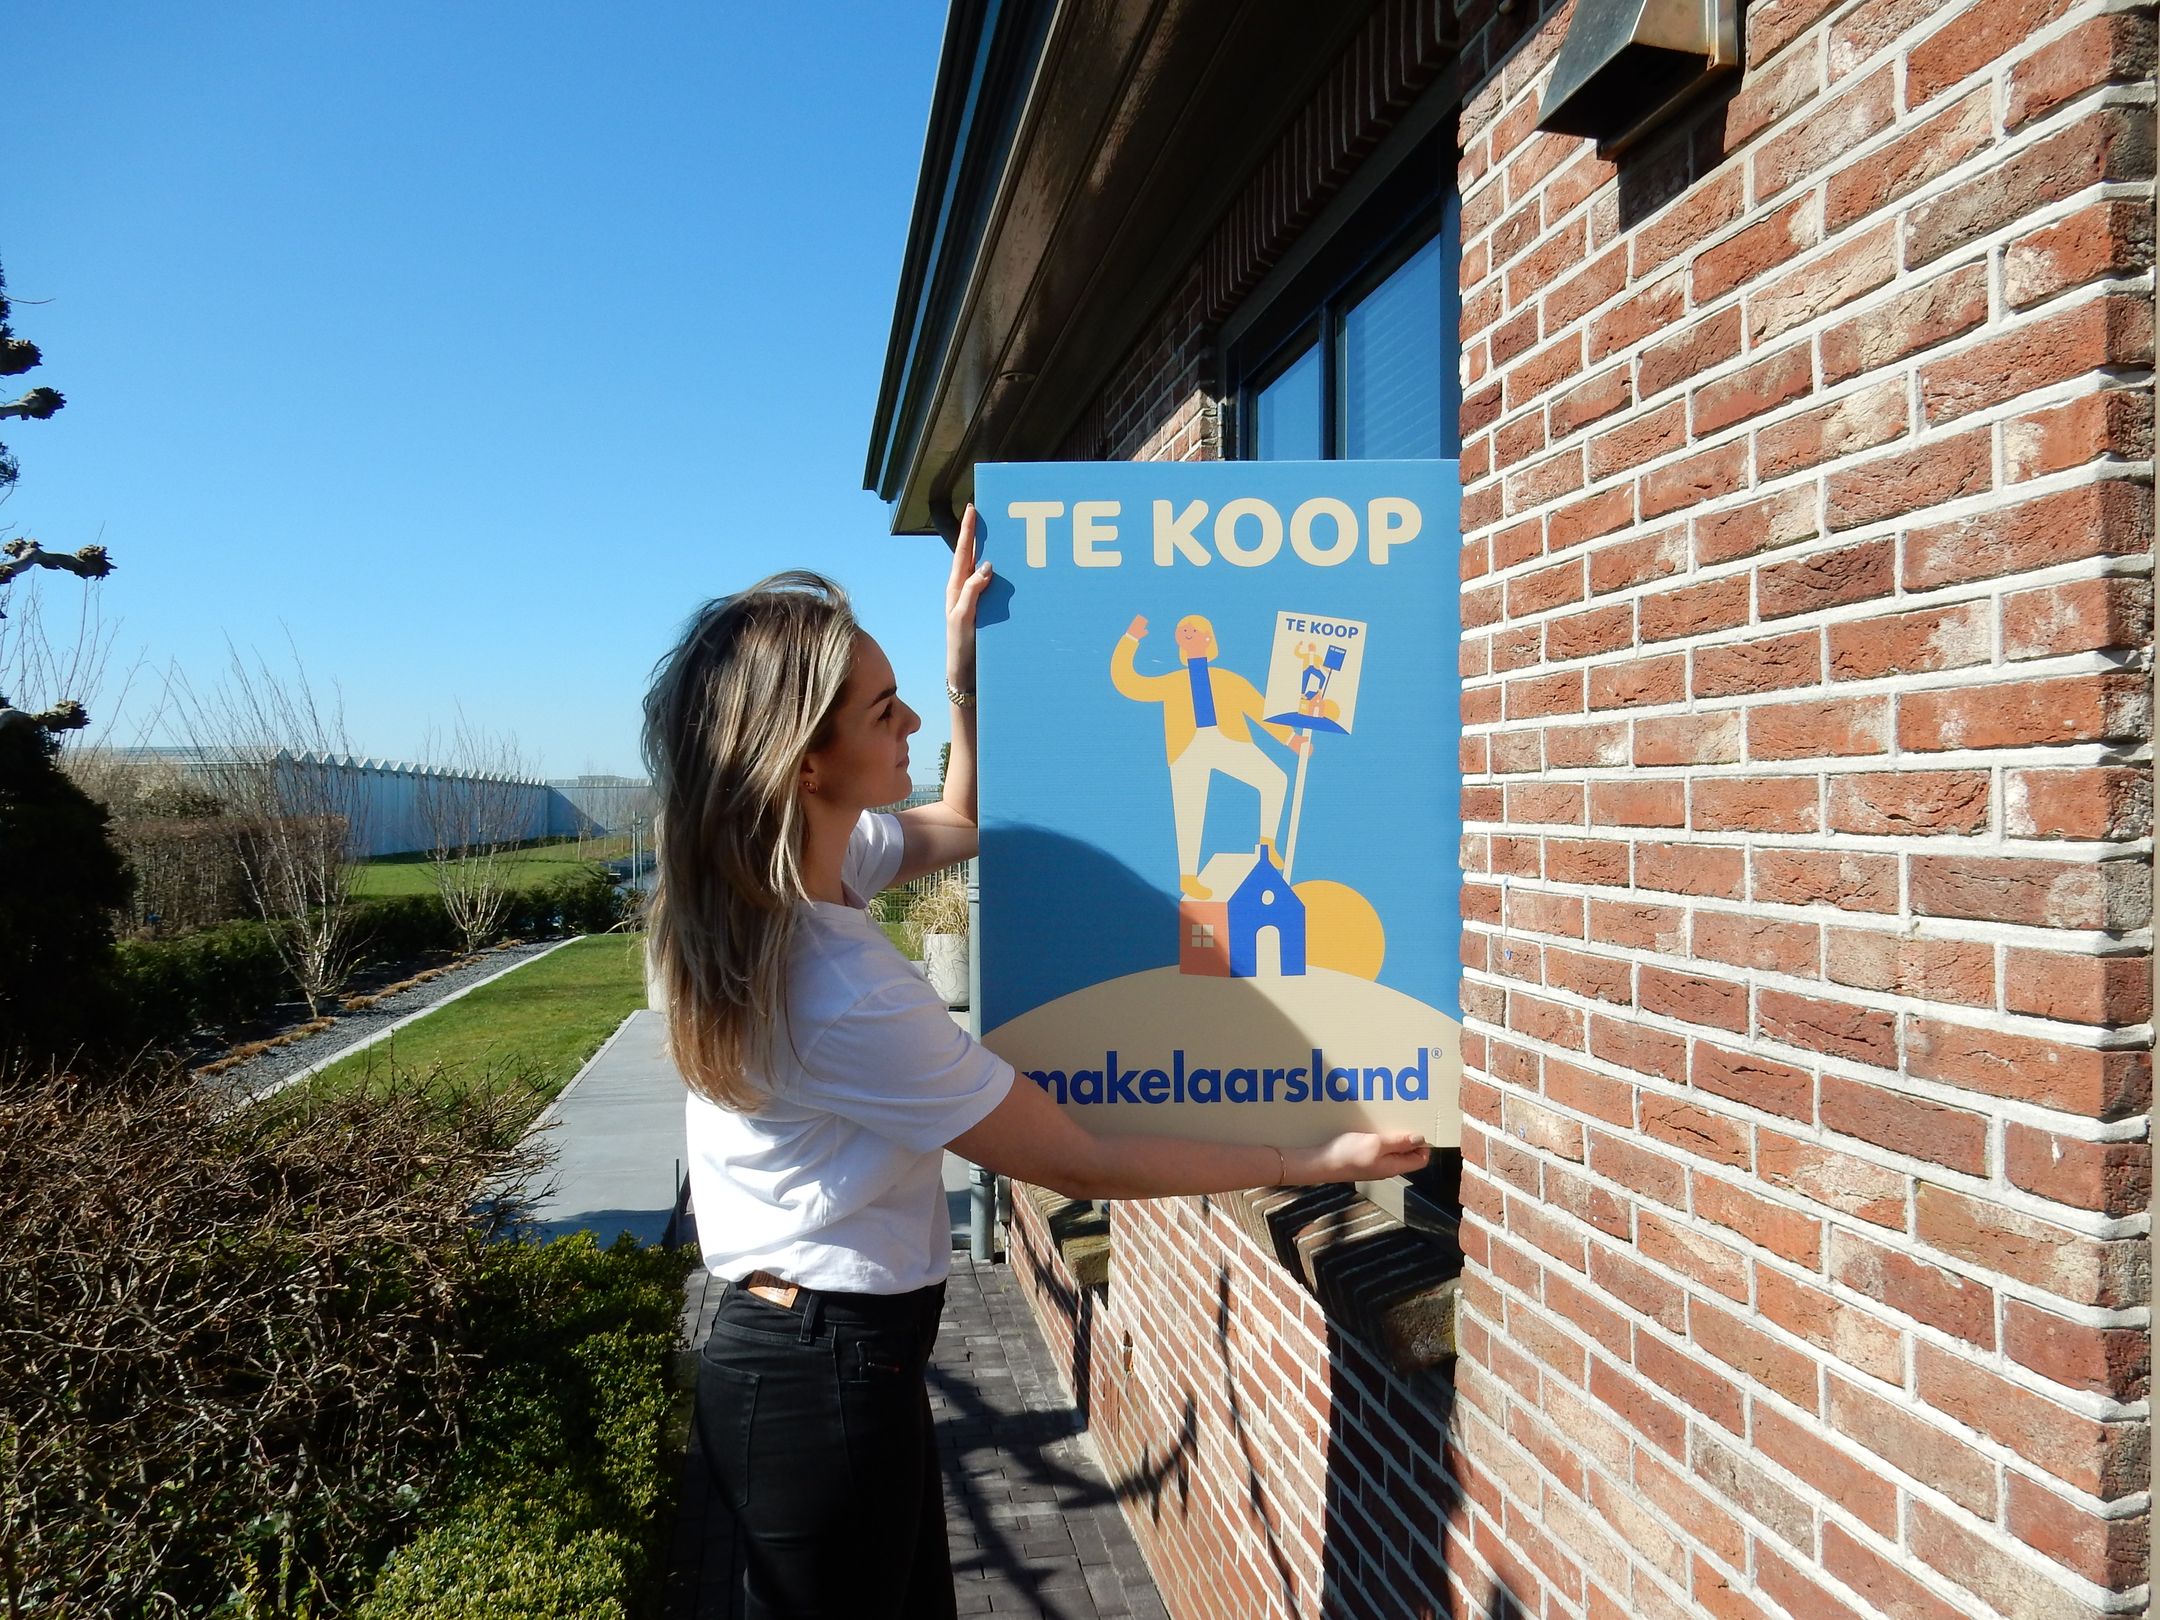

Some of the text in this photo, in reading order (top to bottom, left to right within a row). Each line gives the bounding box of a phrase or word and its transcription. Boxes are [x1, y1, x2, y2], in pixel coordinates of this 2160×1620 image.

[1007, 496, 1423, 569] TE KOOP
[1285, 617, 1359, 639] TE KOOP
